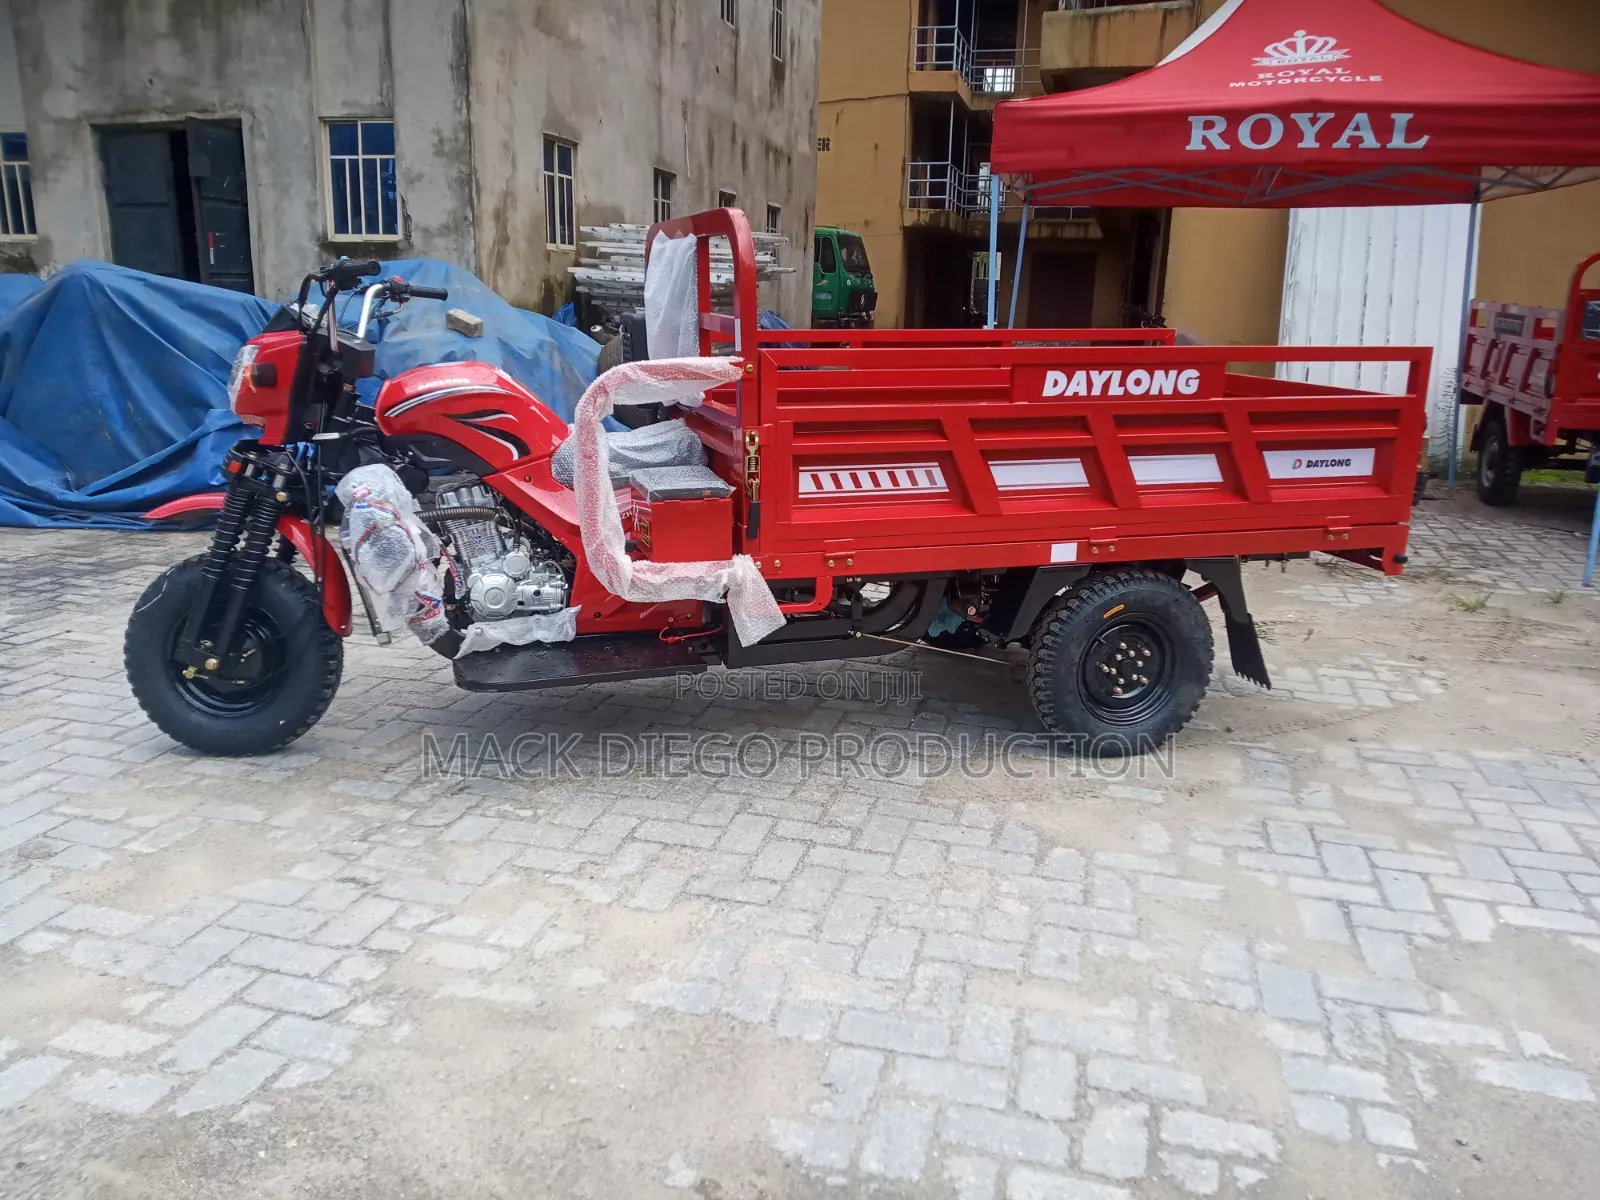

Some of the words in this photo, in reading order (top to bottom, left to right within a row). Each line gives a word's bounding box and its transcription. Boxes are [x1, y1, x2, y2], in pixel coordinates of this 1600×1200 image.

[1257, 67, 1352, 80] ROYAL
[1229, 75, 1384, 88] MOTORCYCLE
[1185, 112, 1431, 150] ROYAL
[1042, 368, 1201, 397] DAYLONG
[1306, 458, 1352, 469] DAYLONG
